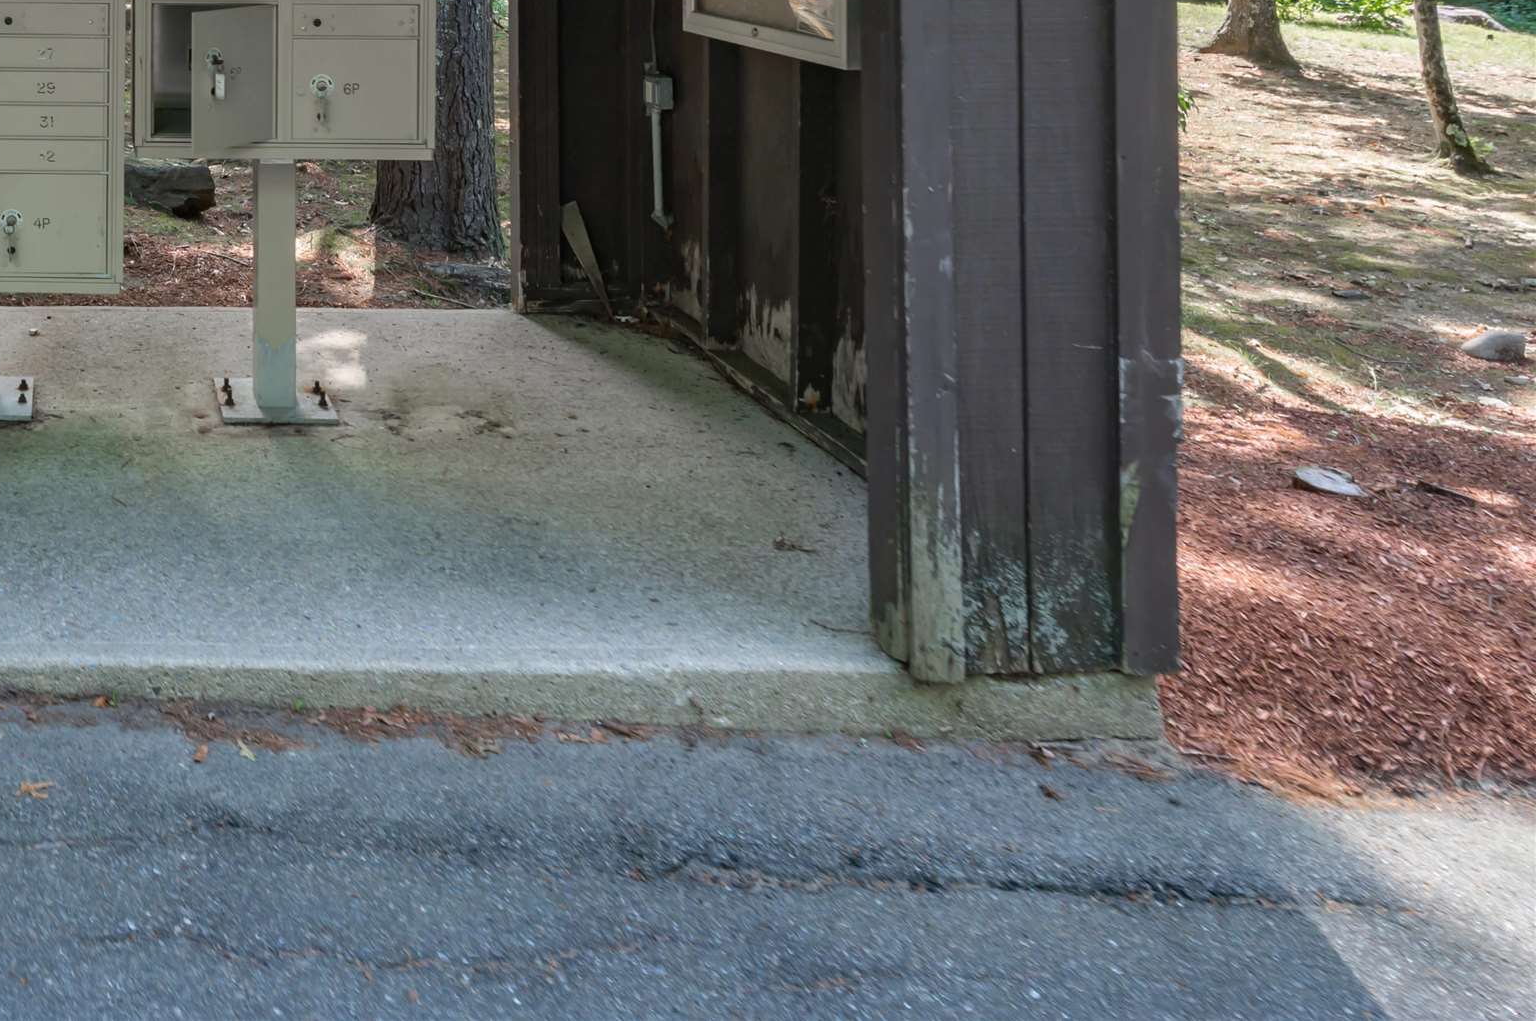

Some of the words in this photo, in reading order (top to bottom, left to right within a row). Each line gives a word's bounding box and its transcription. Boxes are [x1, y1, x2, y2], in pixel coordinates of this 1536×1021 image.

[37, 82, 56, 95] 29
[344, 83, 360, 95] 6P
[40, 116, 54, 128] 31
[33, 217, 50, 229] 4P
